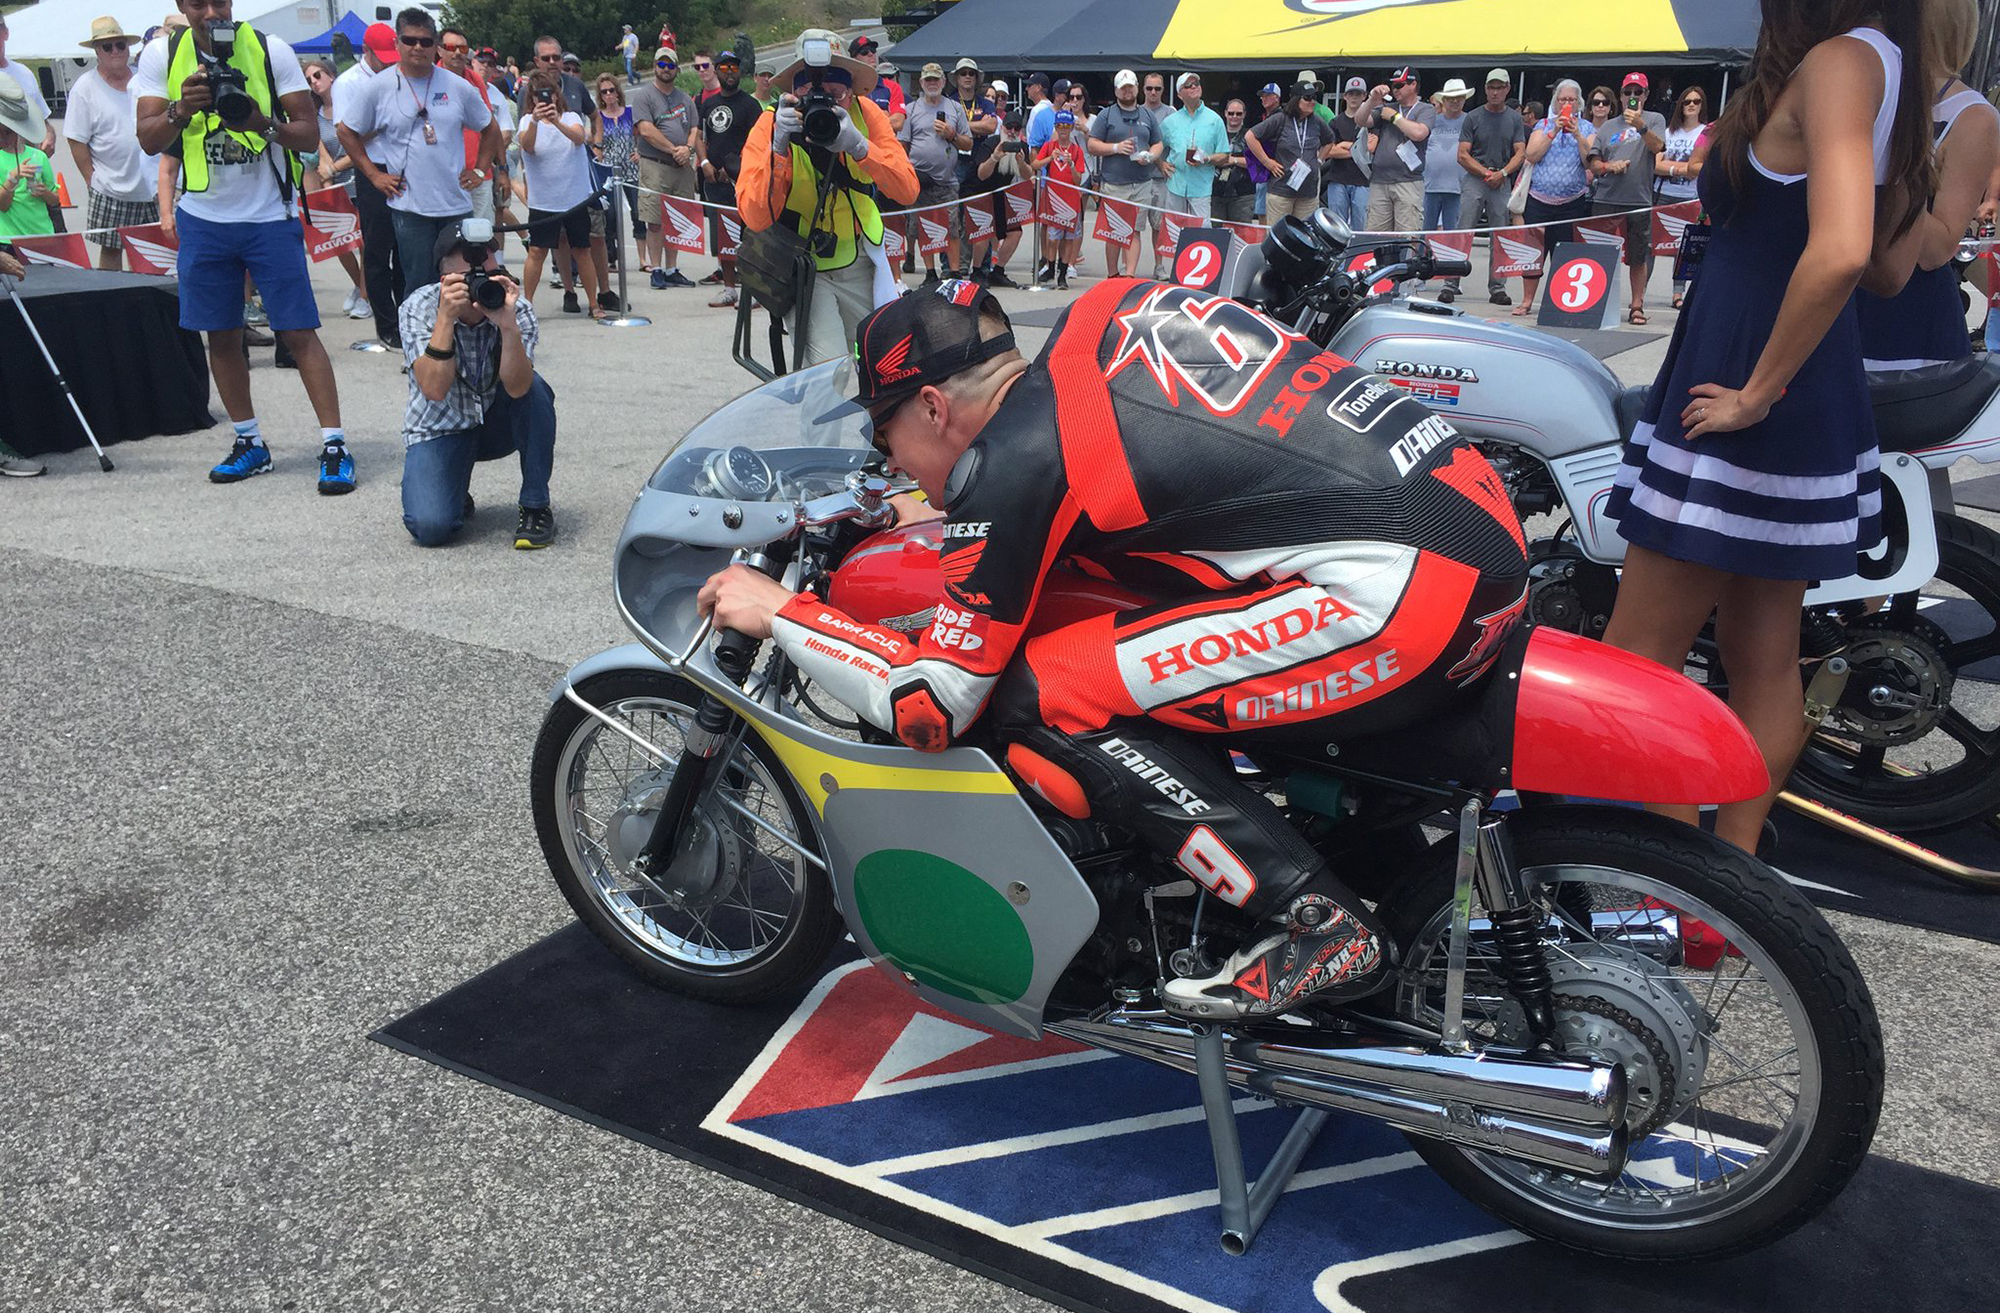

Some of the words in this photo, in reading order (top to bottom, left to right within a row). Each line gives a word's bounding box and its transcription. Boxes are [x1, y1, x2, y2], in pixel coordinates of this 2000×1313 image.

[1183, 245, 1212, 286] 2
[1561, 263, 1594, 308] 3
[879, 366, 921, 386] HONDA
[1375, 359, 1479, 383] HONDA
[1409, 381, 1440, 389] HONDA
[935, 603, 975, 628] RIDE
[930, 622, 983, 650] RED
[1141, 596, 1361, 684] HONDA
[804, 637, 850, 662] Honda
[849, 656, 889, 686] Raci
